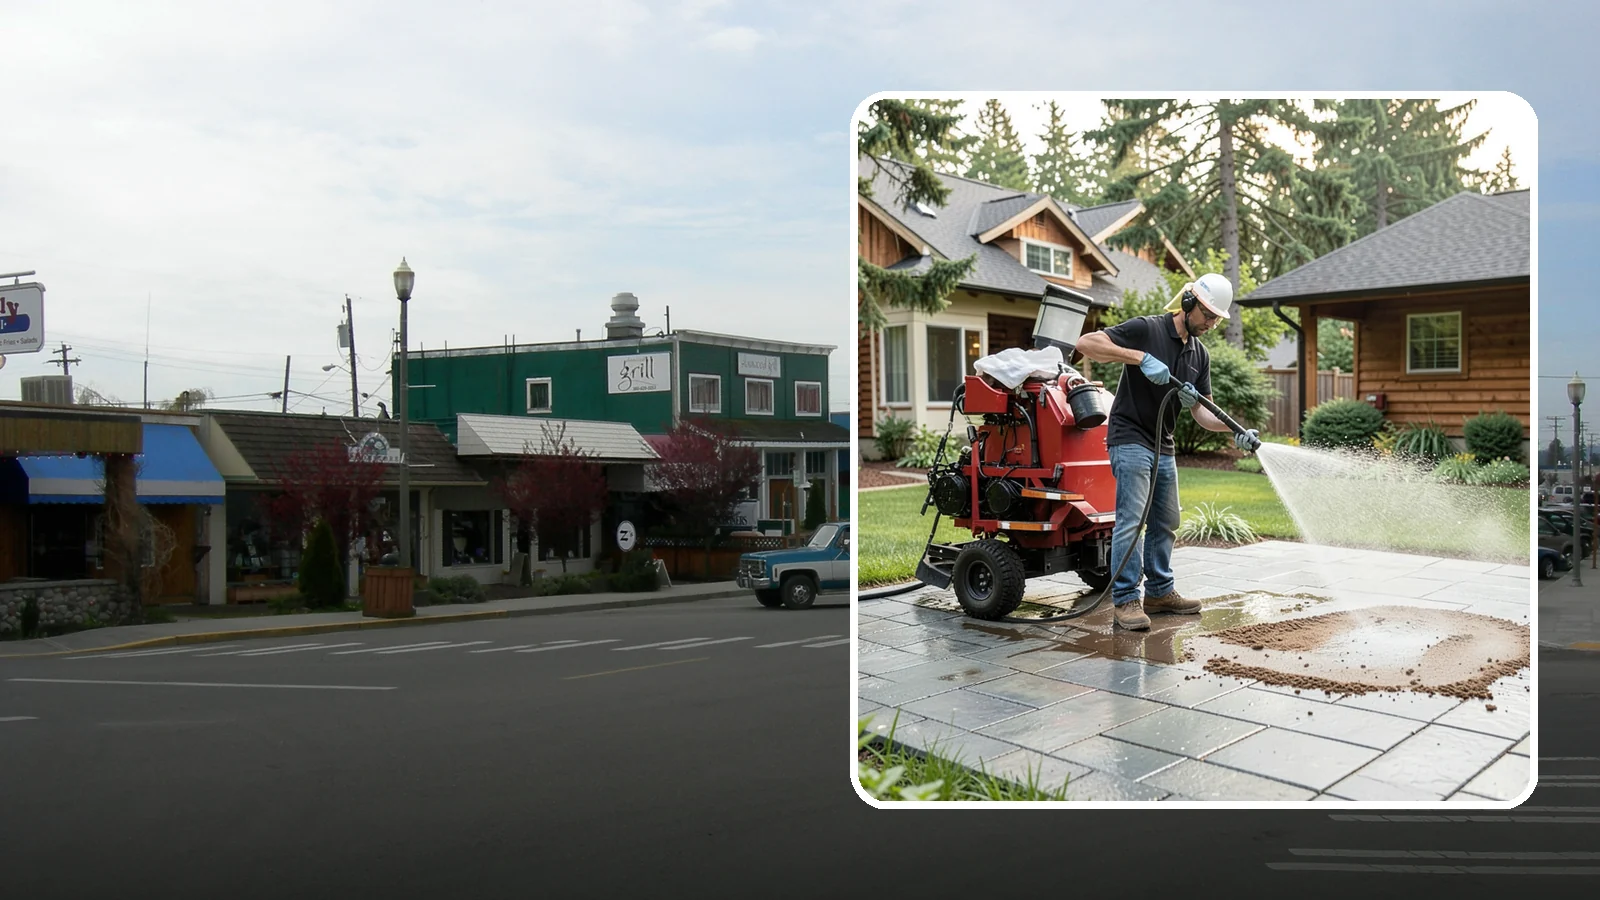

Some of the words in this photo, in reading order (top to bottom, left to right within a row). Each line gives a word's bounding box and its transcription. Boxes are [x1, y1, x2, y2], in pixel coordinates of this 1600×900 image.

[3, 338, 16, 346] Fries
[20, 336, 38, 345] Salads
[617, 355, 655, 392] grill
